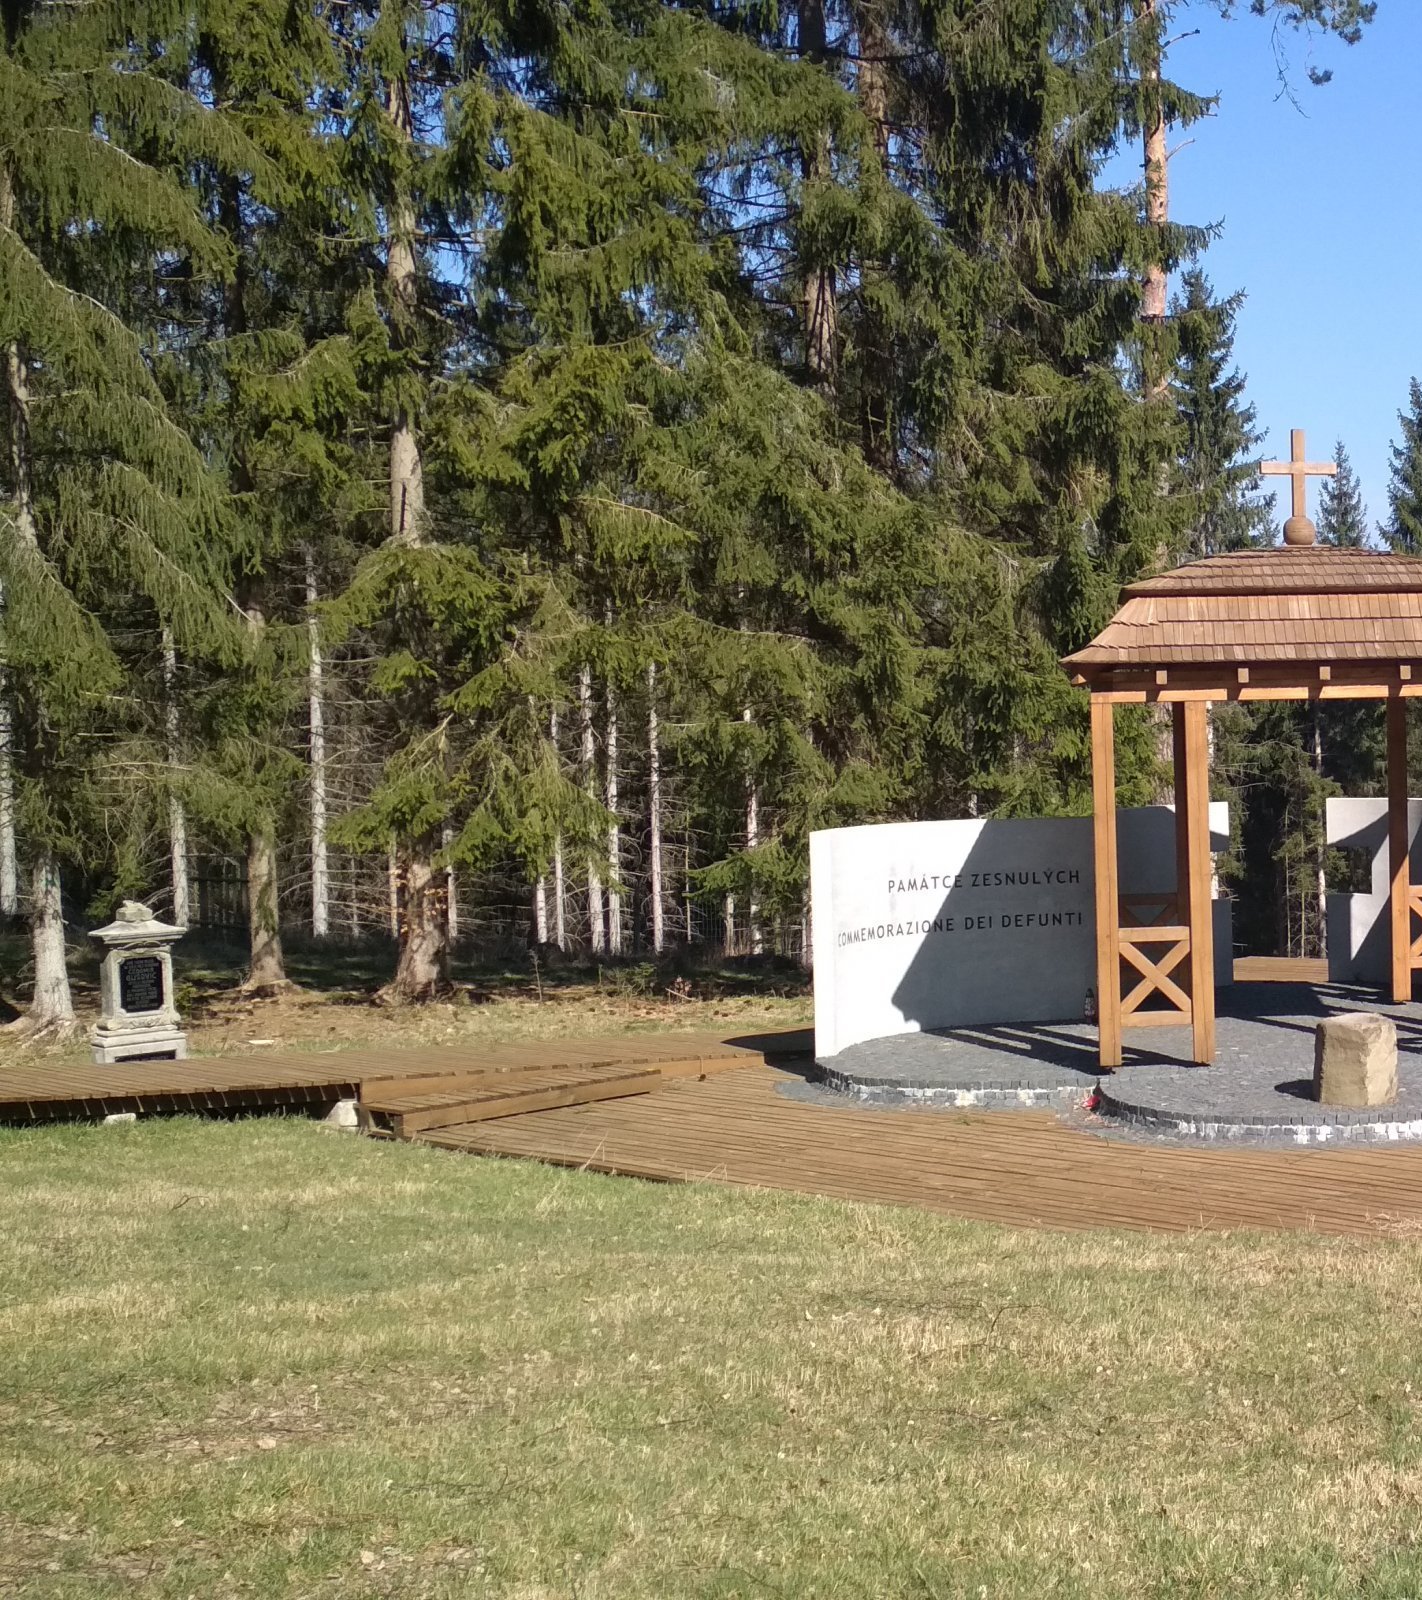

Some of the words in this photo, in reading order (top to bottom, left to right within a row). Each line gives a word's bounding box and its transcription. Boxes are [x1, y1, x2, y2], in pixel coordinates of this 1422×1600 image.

[888, 873, 963, 893] PAMÁTCE
[971, 867, 1080, 887] ZESNULÝCH
[837, 918, 955, 948] COMMEMORAZIONE
[964, 915, 993, 930] DEI
[1001, 912, 1083, 929] DEFUNTI
